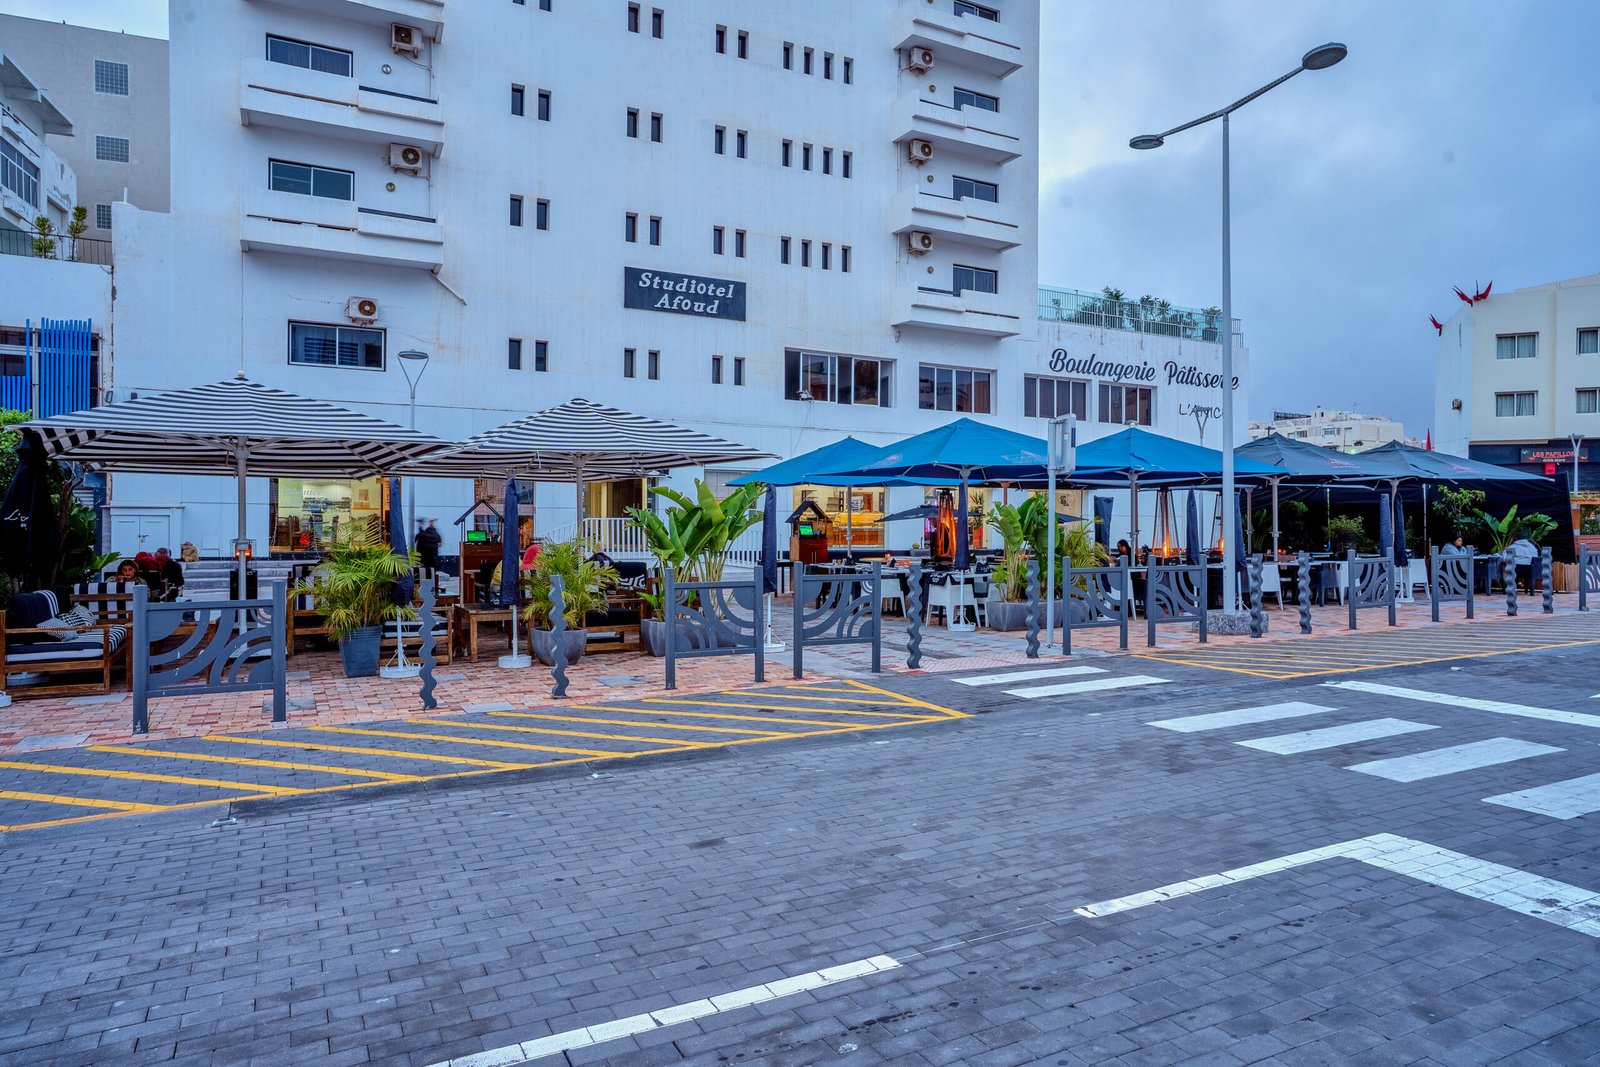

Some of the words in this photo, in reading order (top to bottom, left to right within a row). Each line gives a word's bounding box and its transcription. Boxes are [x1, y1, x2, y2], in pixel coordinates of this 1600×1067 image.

[638, 272, 735, 299] Studiotel
[654, 293, 720, 314] Afoud
[1048, 347, 1156, 382] Boulangerie
[1164, 360, 1240, 390] Pâtissere
